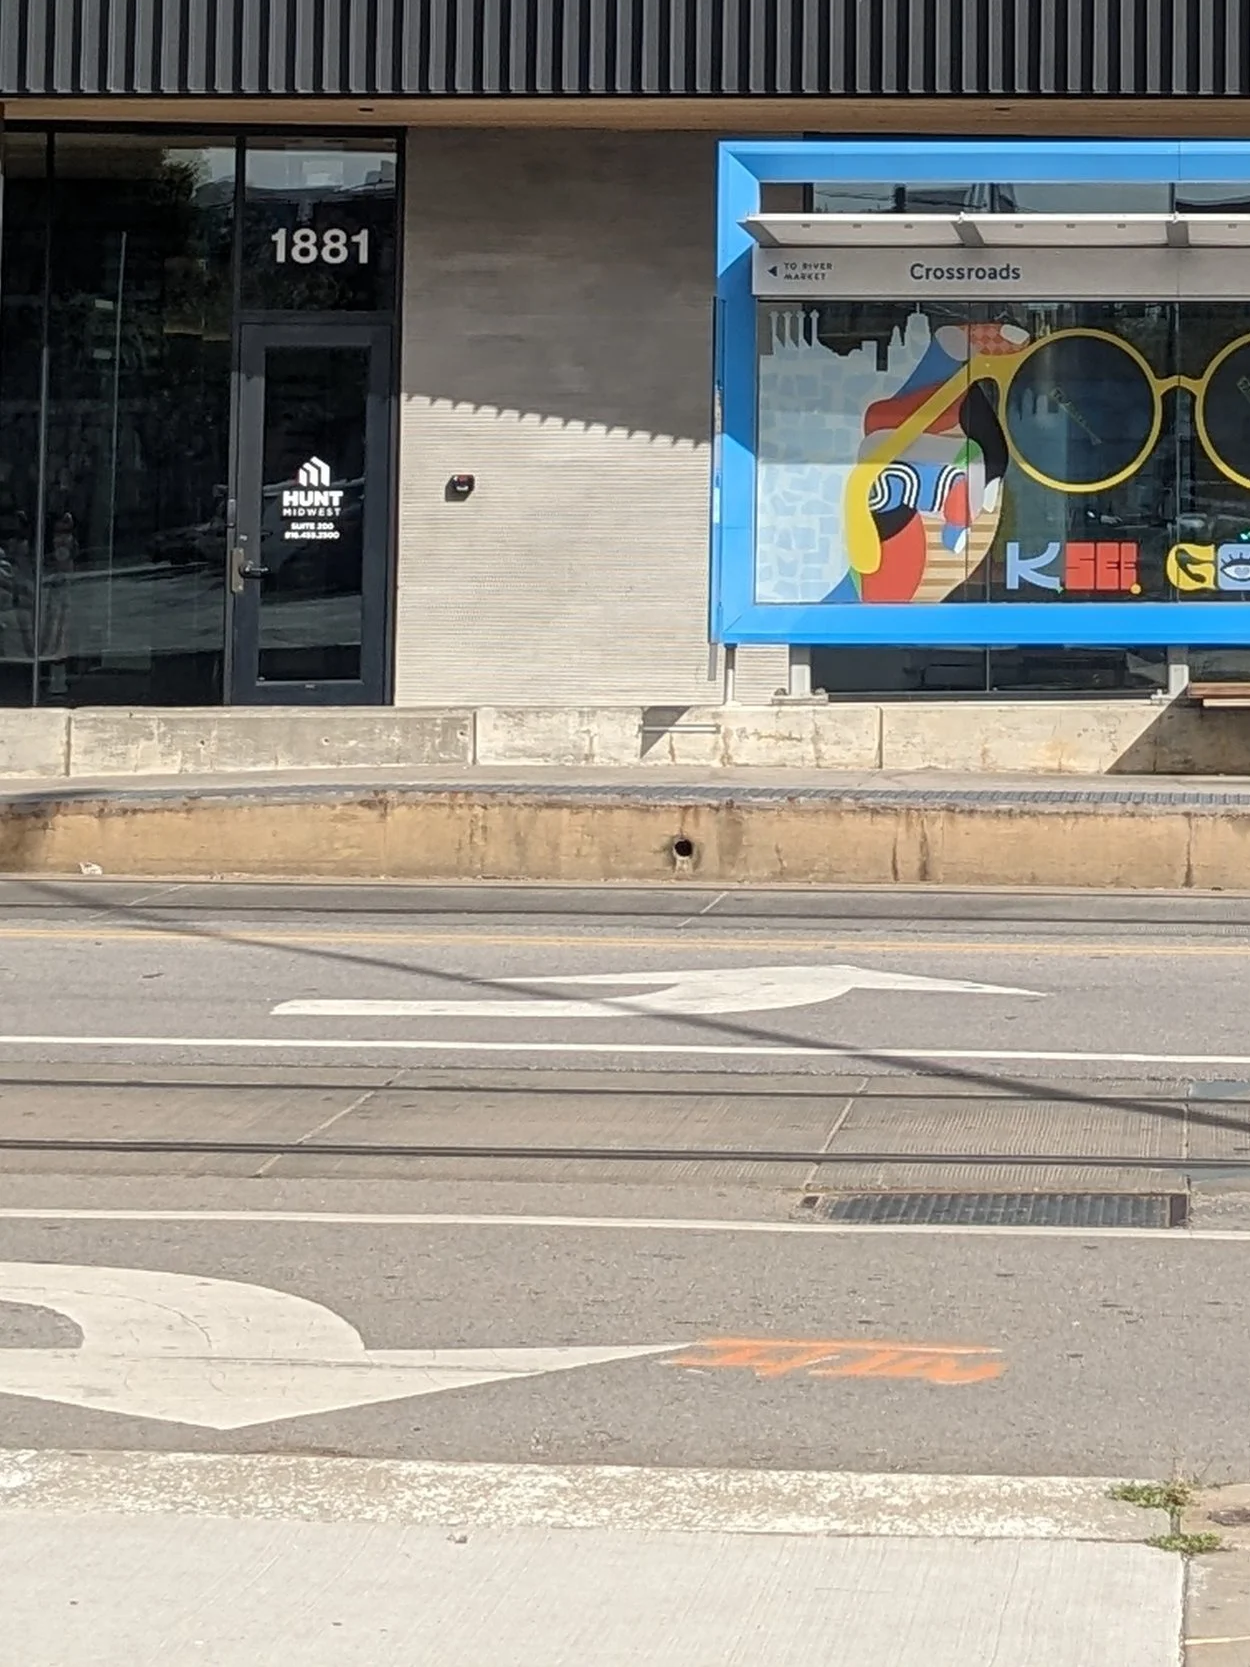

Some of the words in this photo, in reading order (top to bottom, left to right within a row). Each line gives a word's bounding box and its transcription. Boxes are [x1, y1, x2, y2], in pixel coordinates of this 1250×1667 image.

[271, 228, 368, 264] 1881
[784, 262, 798, 271] TO
[910, 263, 1021, 280] Crossroads
[783, 272, 827, 281] MARKET
[282, 490, 344, 507] HUNT
[282, 507, 341, 517] MIDWEST
